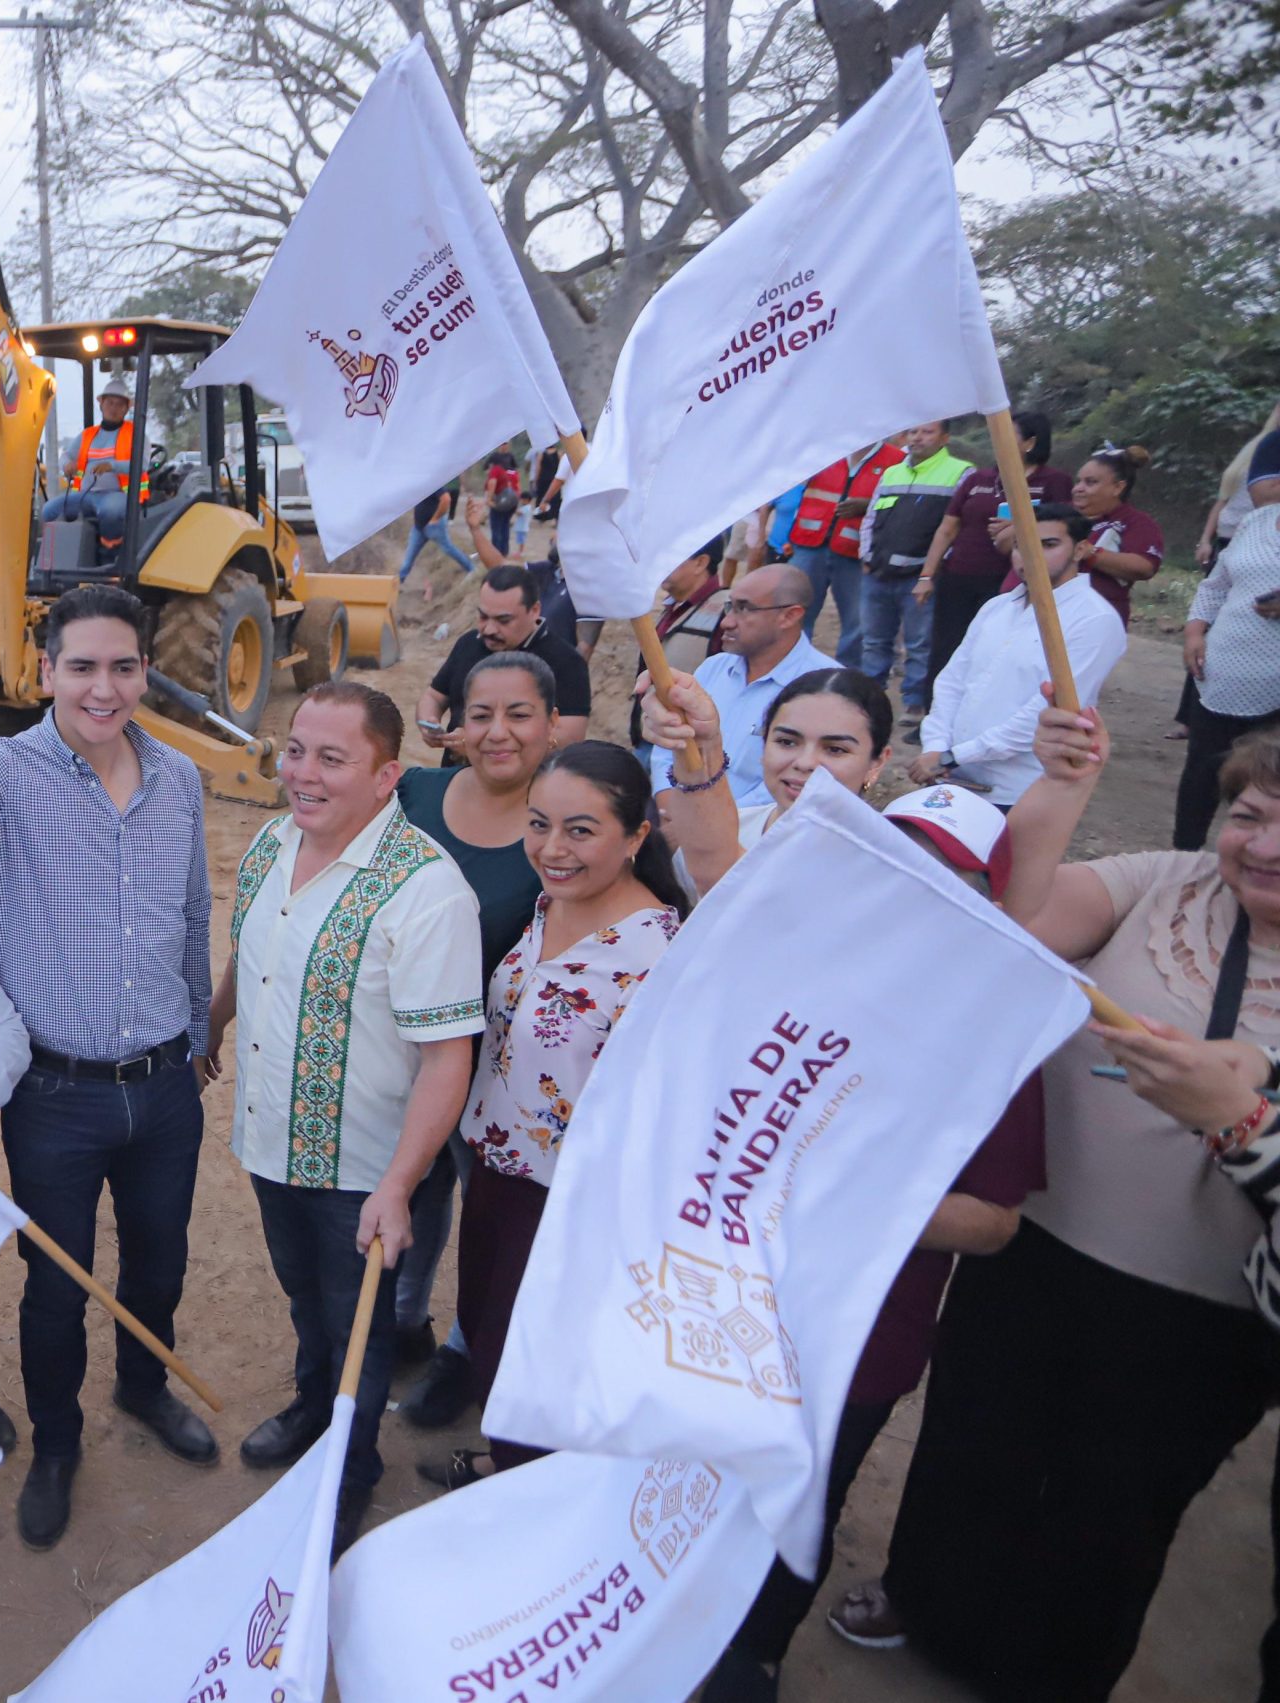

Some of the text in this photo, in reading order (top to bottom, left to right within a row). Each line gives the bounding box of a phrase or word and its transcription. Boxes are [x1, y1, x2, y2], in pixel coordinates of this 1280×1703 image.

[393, 260, 436, 302] Destino
[756, 268, 815, 308] donde
[392, 301, 430, 335] tus
[405, 337, 430, 366] se
[698, 308, 837, 402] cumplen!
[748, 1010, 810, 1076] DE
[721, 1029, 851, 1246] BANDERAS
[449, 1561, 630, 1703] BANDERAS
[450, 1583, 568, 1651] AYUNTAMIENTO
[536, 1585, 645, 1690] BAHÍA
[204, 1647, 231, 1674] se
